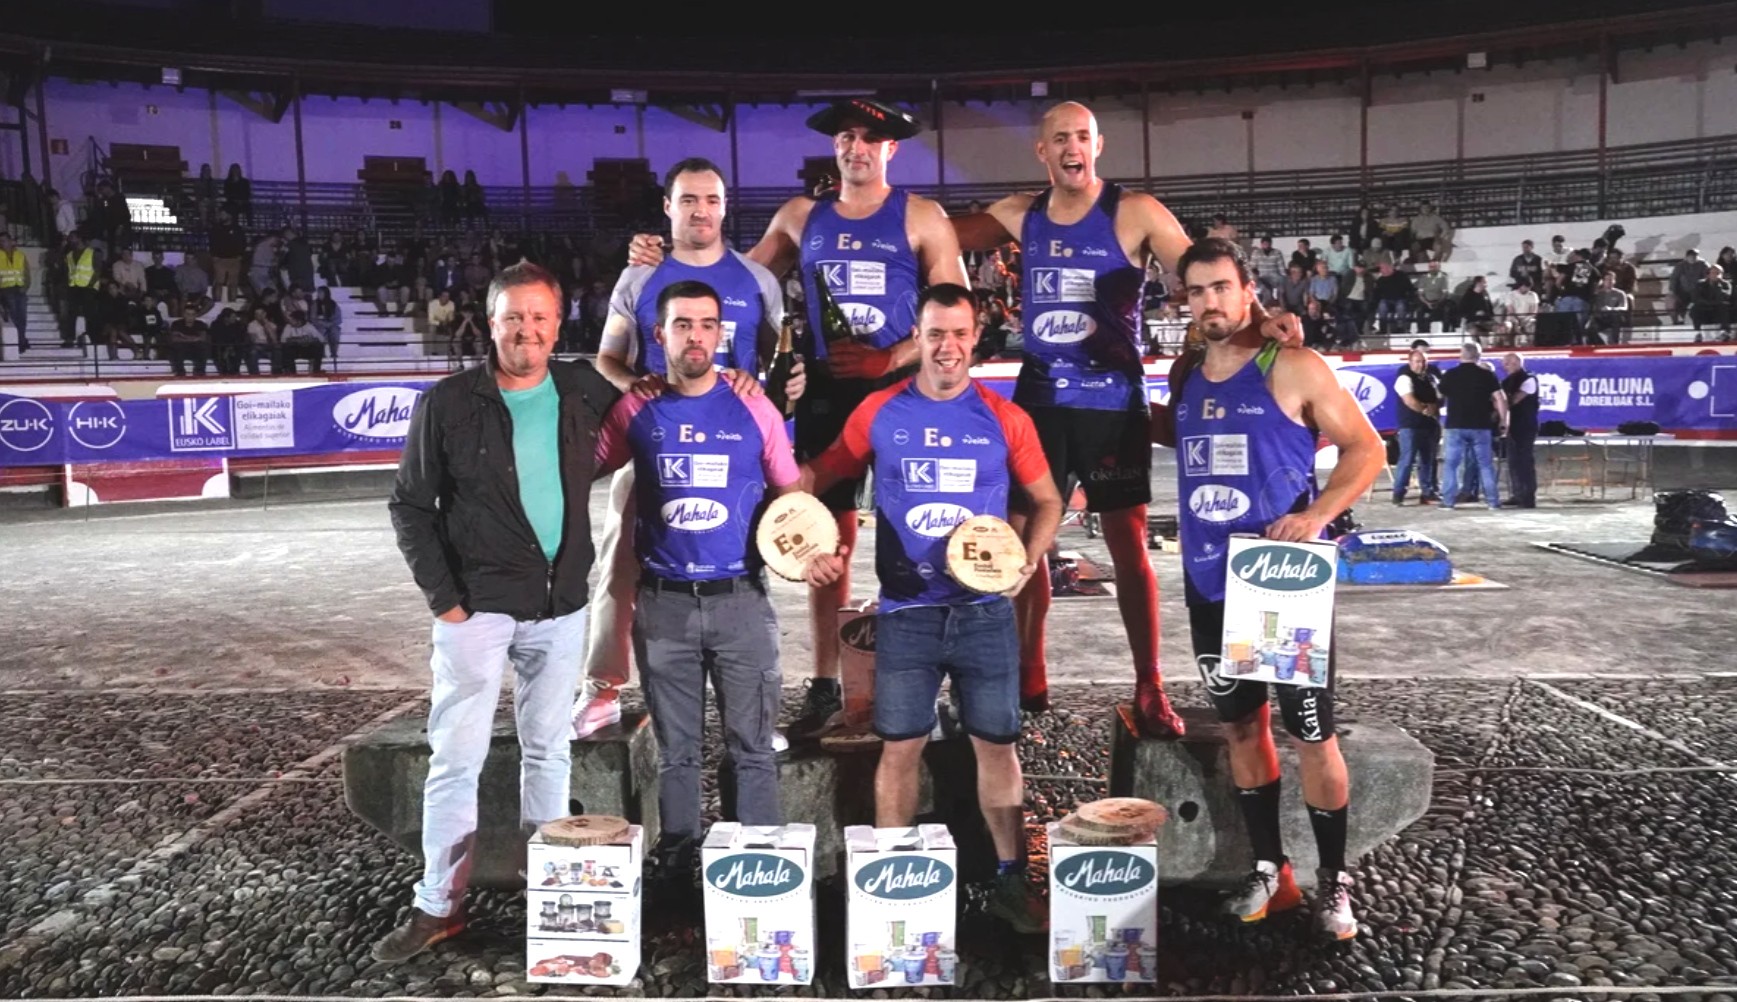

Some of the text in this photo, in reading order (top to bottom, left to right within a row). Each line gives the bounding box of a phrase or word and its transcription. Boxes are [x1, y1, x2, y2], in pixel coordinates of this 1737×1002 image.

[850, 307, 877, 327] hala
[1037, 314, 1087, 337] Mahala
[1578, 377, 1654, 395] OTALUNA
[1578, 396, 1655, 407] ADREILUAK S.L.
[241, 410, 287, 422] elikagaiak
[175, 435, 231, 448] EUSKO LABEL
[666, 502, 719, 525] Mahala
[1239, 552, 1319, 582] Mahala
[715, 859, 791, 890] Mahala
[864, 859, 942, 893] Mahala
[1064, 856, 1141, 888] Mahala
